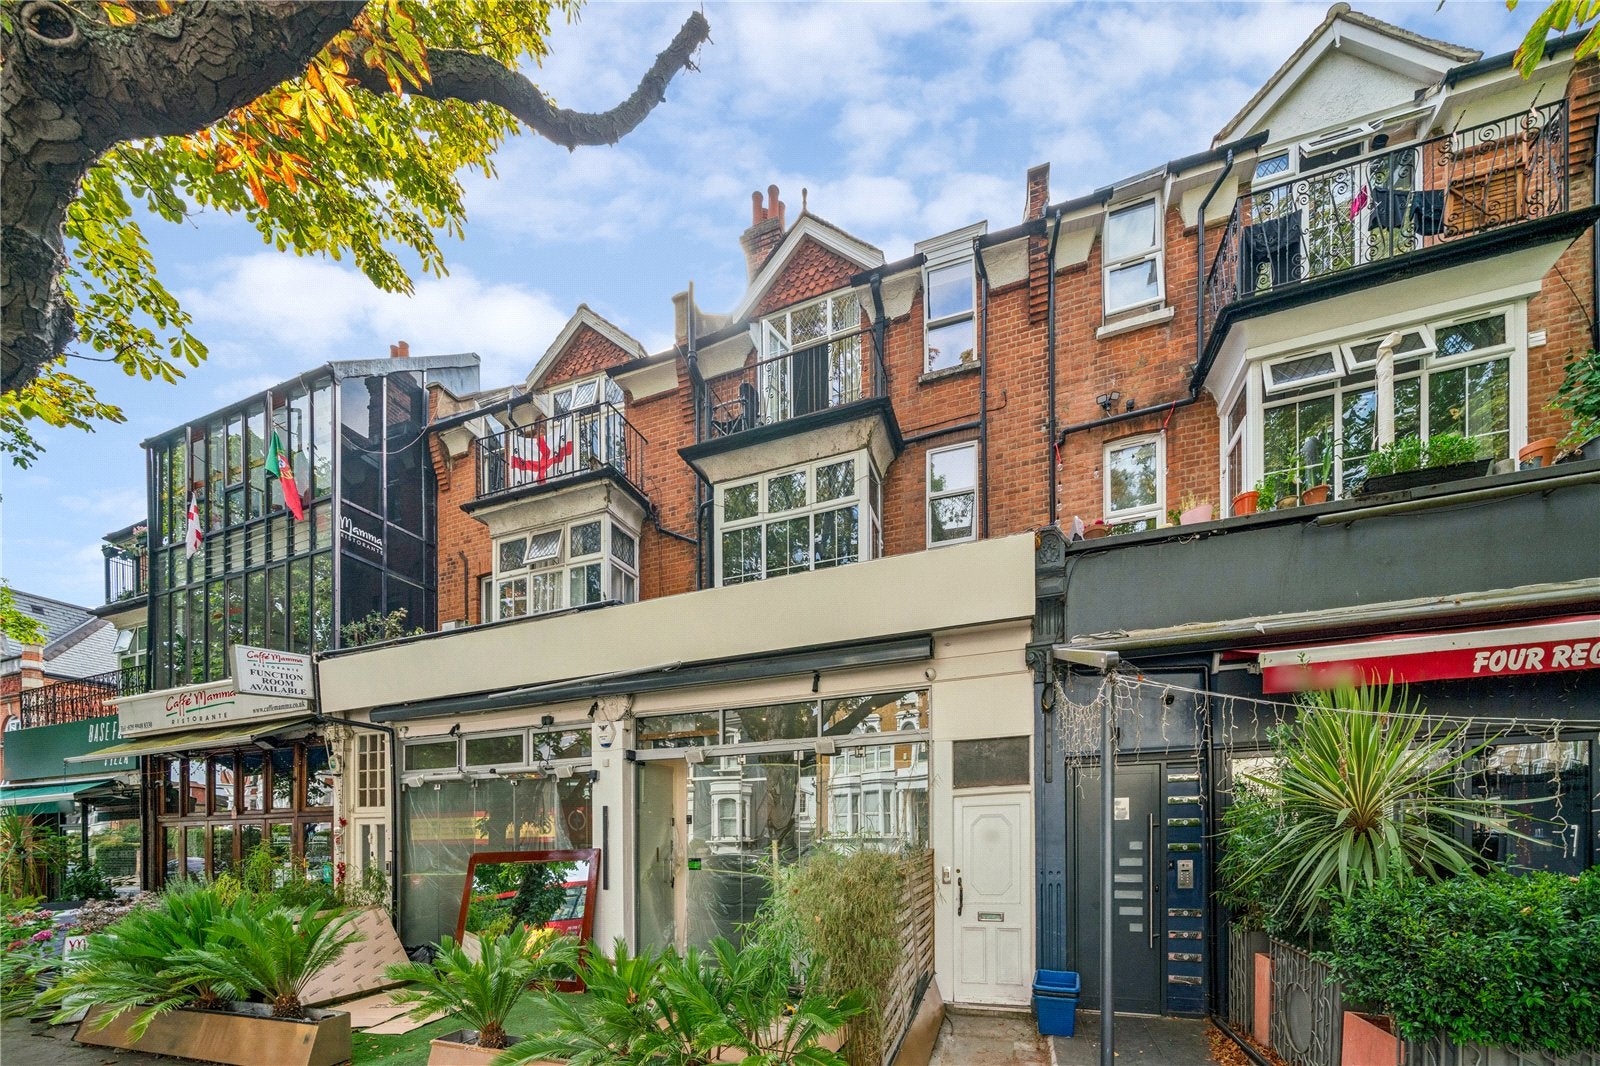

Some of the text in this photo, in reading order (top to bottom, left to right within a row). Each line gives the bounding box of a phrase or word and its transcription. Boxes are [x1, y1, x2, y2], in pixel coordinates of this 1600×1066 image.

[340, 514, 382, 546] Mamma
[271, 653, 303, 663] Mamma
[1472, 646, 1545, 674] FOUR
[249, 668, 304, 681] FUNCTION
[262, 677, 295, 687] ROOM
[249, 683, 307, 695] AVAILABLE
[193, 690, 238, 706] Mamma
[171, 712, 228, 725] RISTORANTE
[88, 722, 110, 743] BASE
